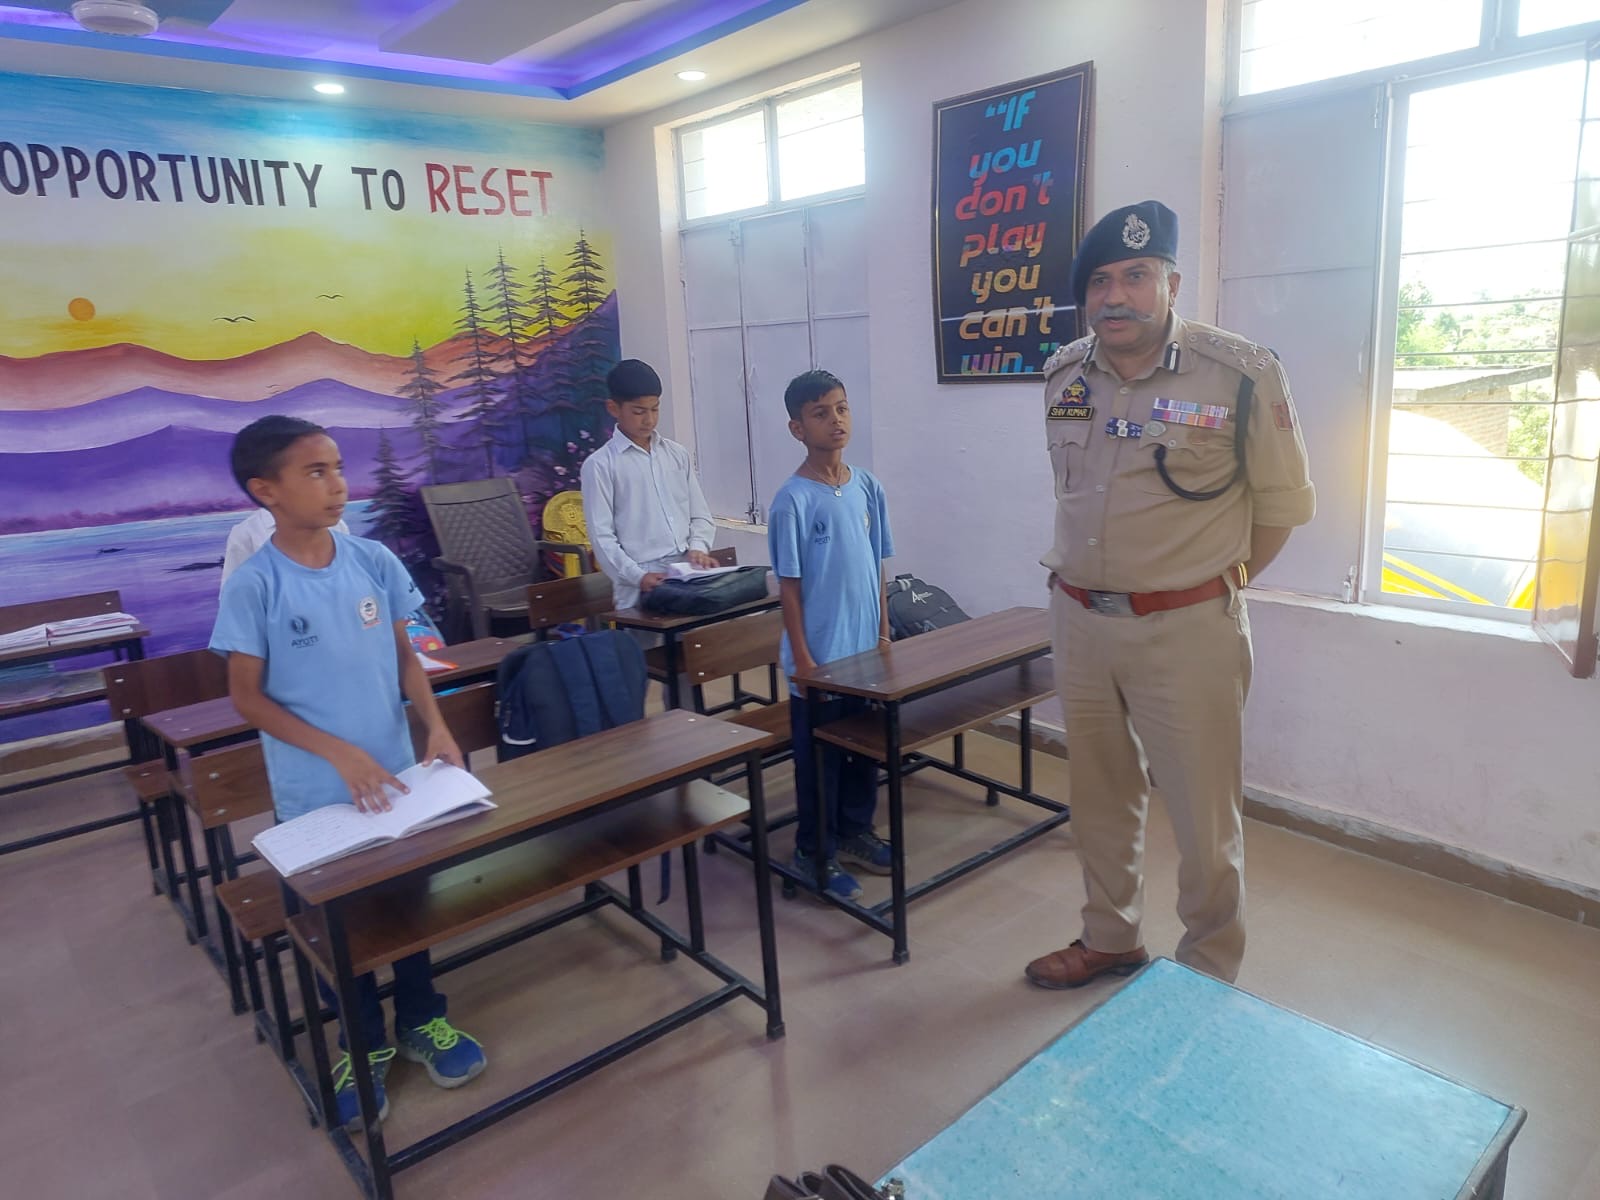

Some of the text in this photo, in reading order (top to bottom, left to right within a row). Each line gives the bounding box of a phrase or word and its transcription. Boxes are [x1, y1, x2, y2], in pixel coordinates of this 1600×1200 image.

[0, 141, 553, 216] OPPORTUNITY TO RESET
[968, 139, 1042, 187] you
[959, 221, 1047, 268] play
[971, 264, 1041, 304] you
